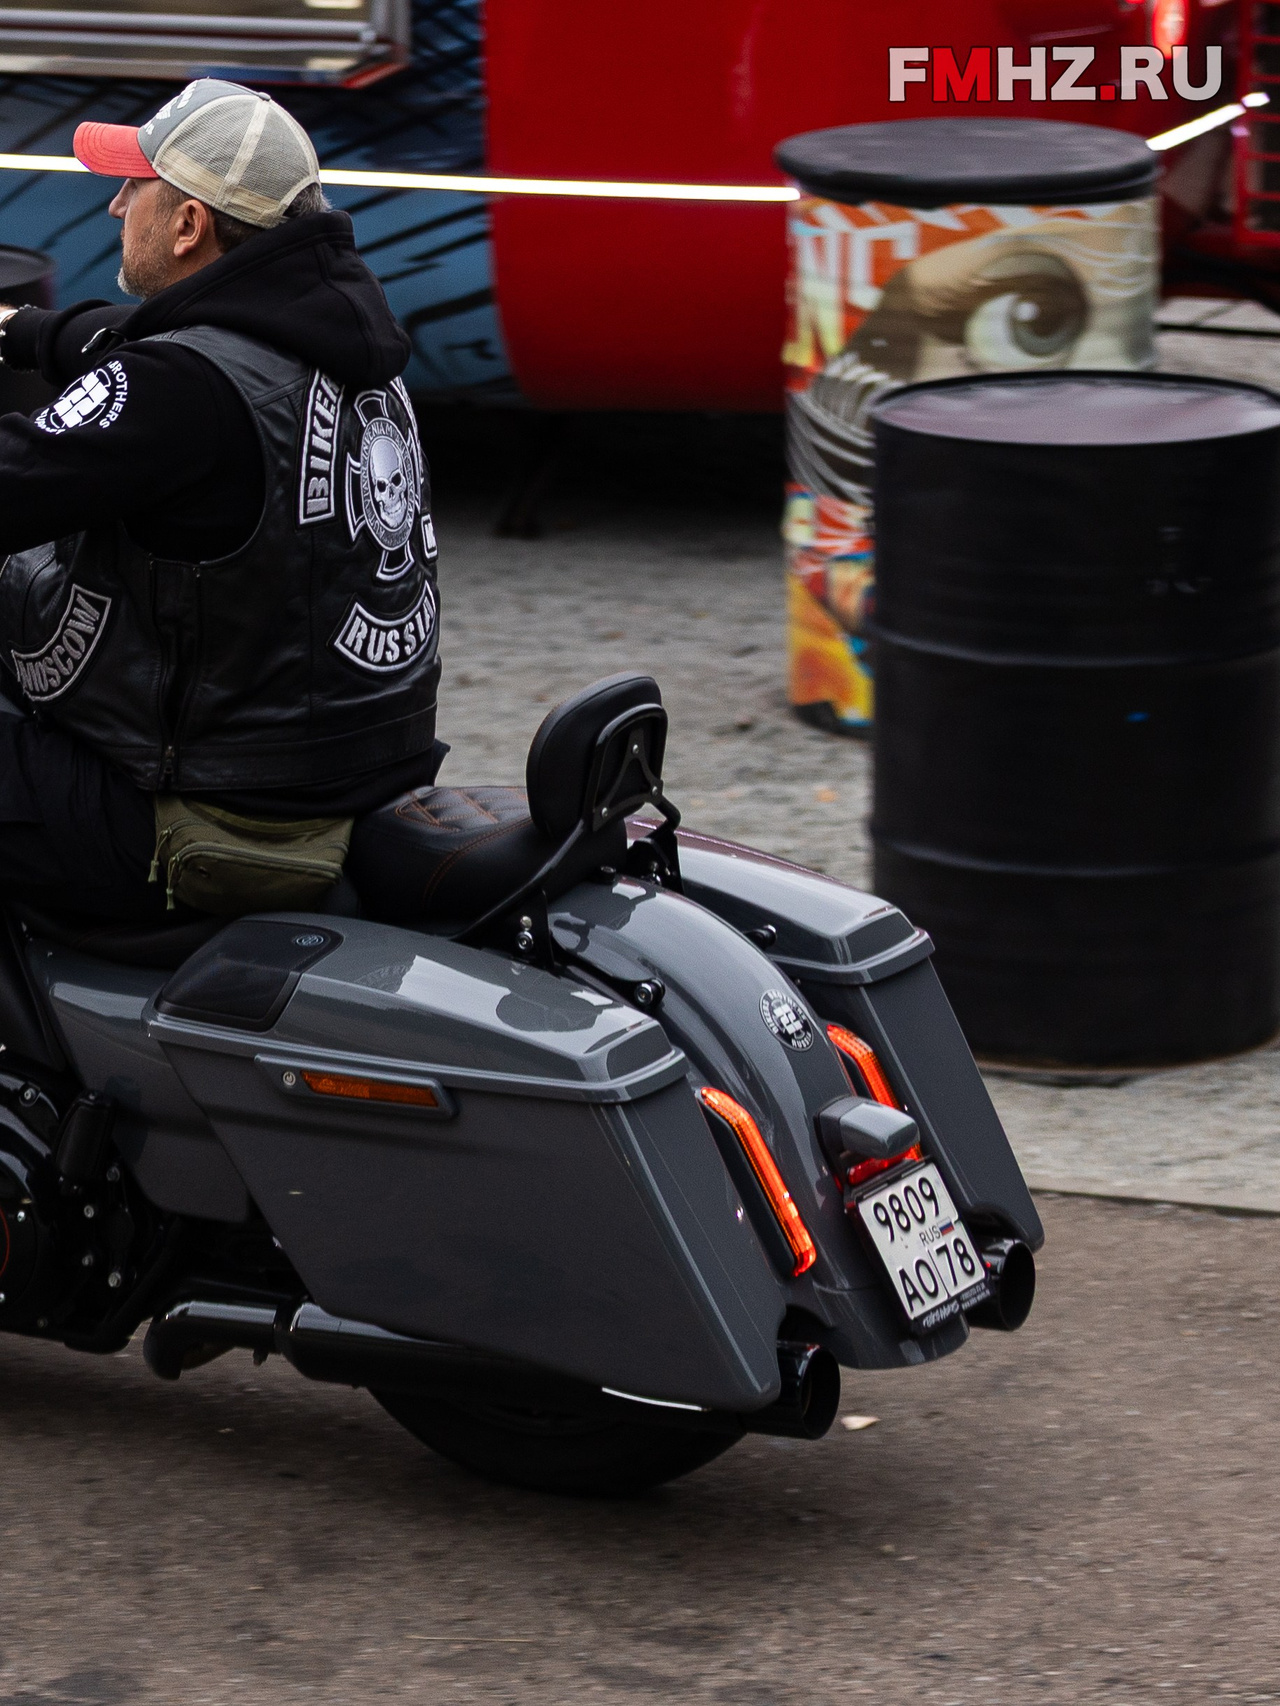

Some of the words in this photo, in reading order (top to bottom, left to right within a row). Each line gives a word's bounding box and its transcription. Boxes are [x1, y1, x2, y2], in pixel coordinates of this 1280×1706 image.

[17, 593, 100, 692] MOSCOW
[345, 596, 434, 663] RUSSIA
[873, 1176, 940, 1243] 9809
[919, 1225, 941, 1246] RUS
